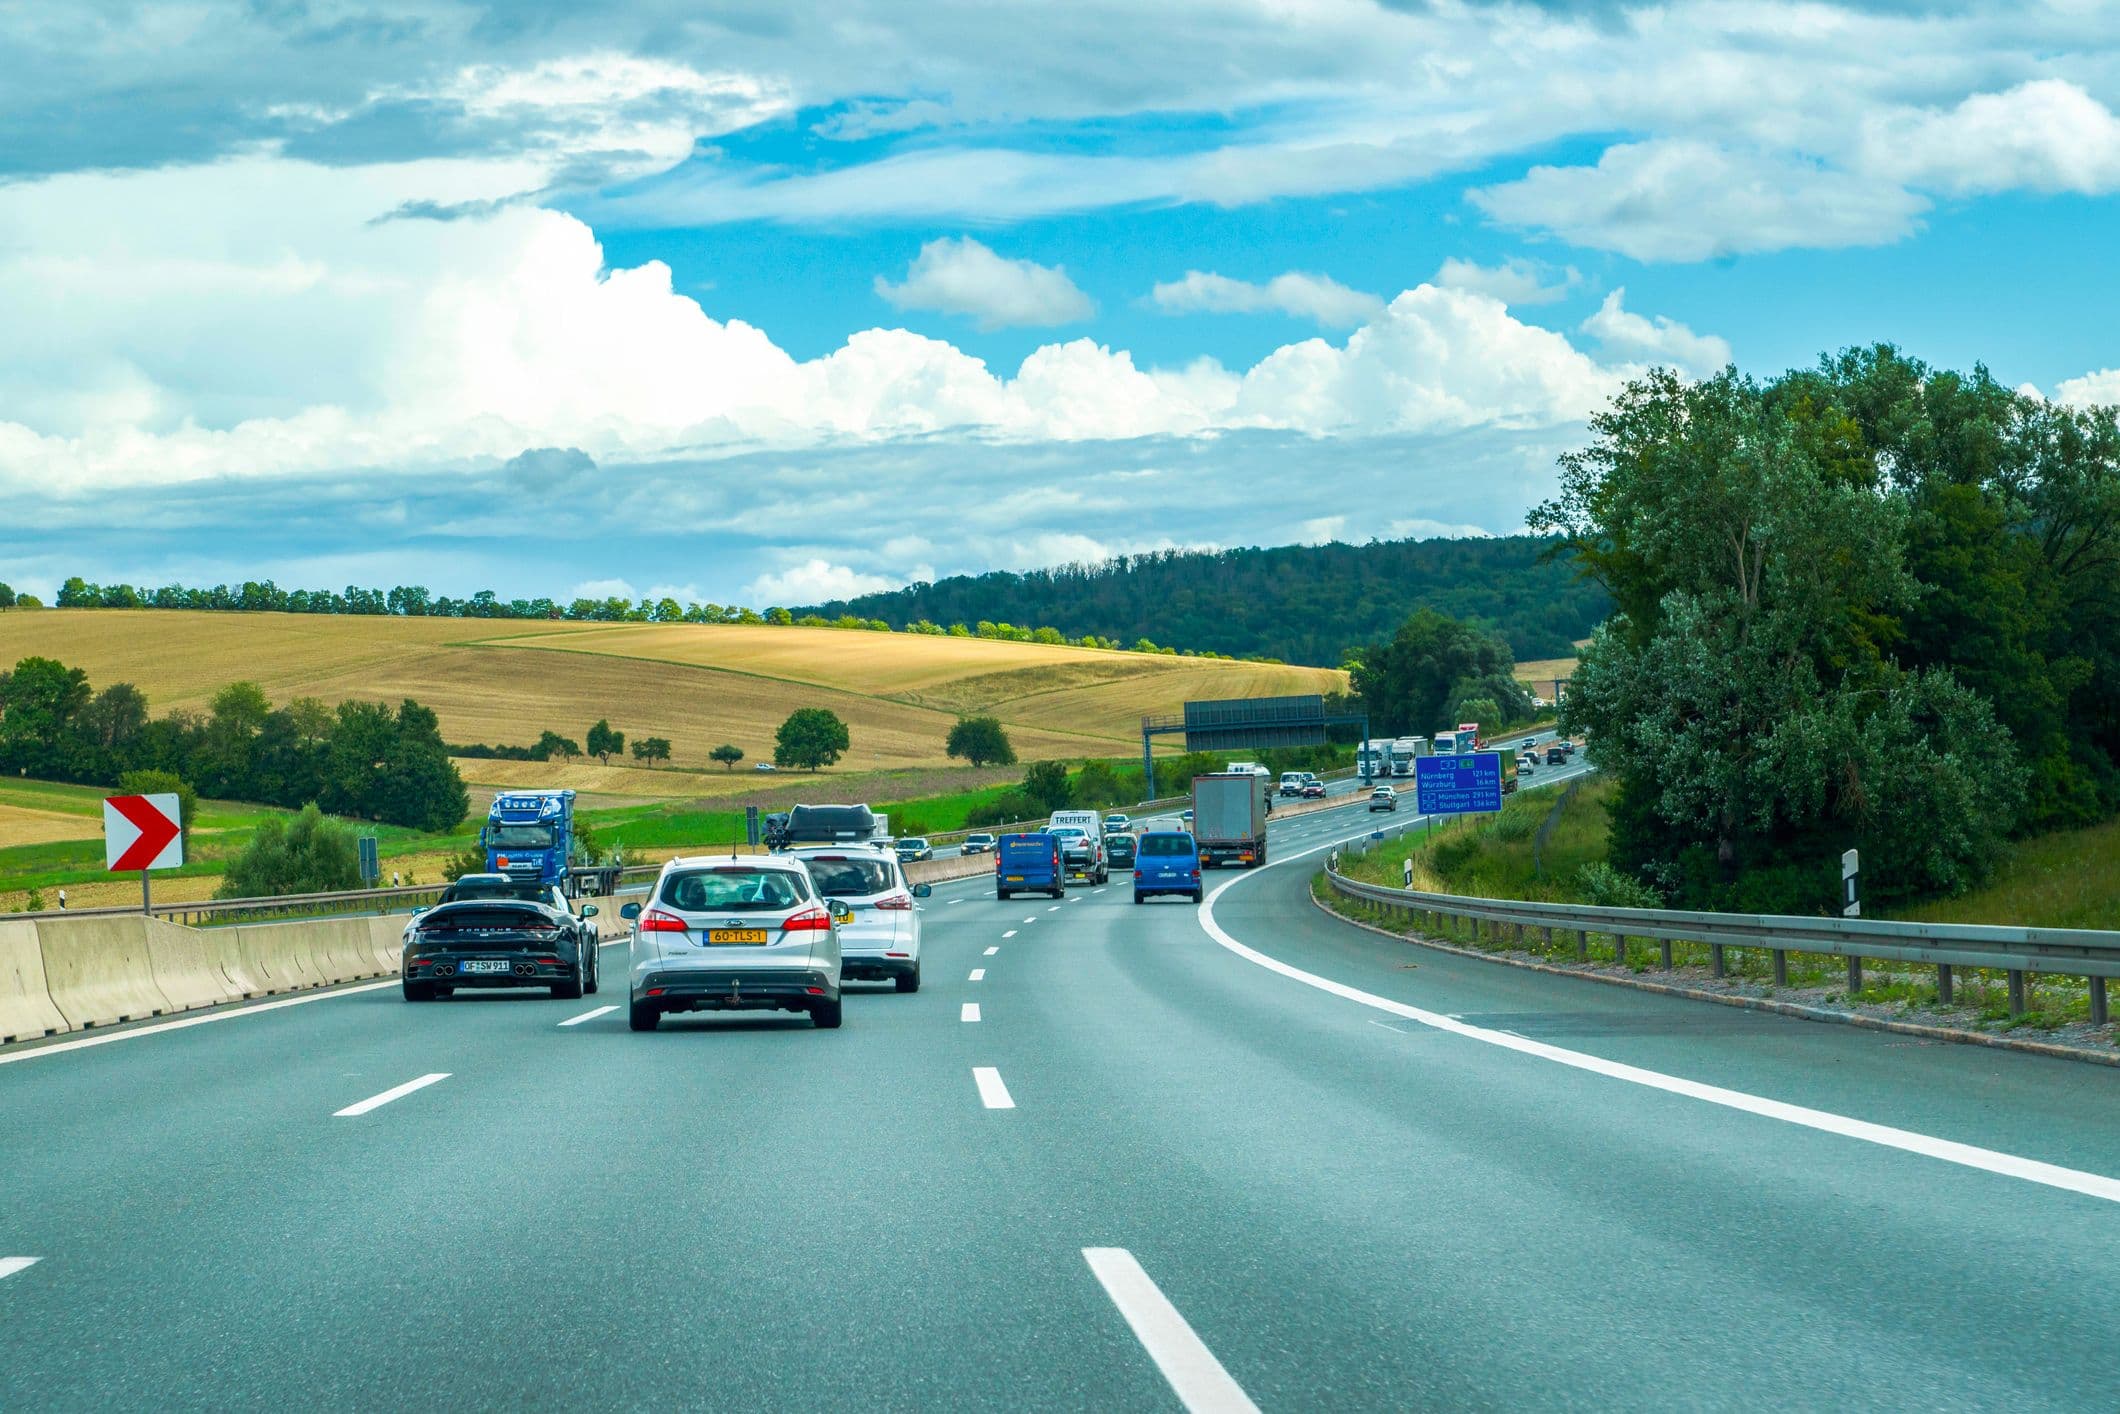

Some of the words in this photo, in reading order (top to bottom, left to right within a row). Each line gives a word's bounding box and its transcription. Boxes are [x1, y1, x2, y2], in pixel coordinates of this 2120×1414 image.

[1421, 781, 1456, 789] Würzburg
[1438, 792, 1470, 800] München
[1439, 800, 1470, 809] Stuttgart
[1485, 799, 1497, 807] km
[1055, 816, 1091, 824] TREFFERT
[714, 931, 762, 941] 60-TLS-1
[480, 962, 492, 970] SW
[493, 962, 509, 970] 911
